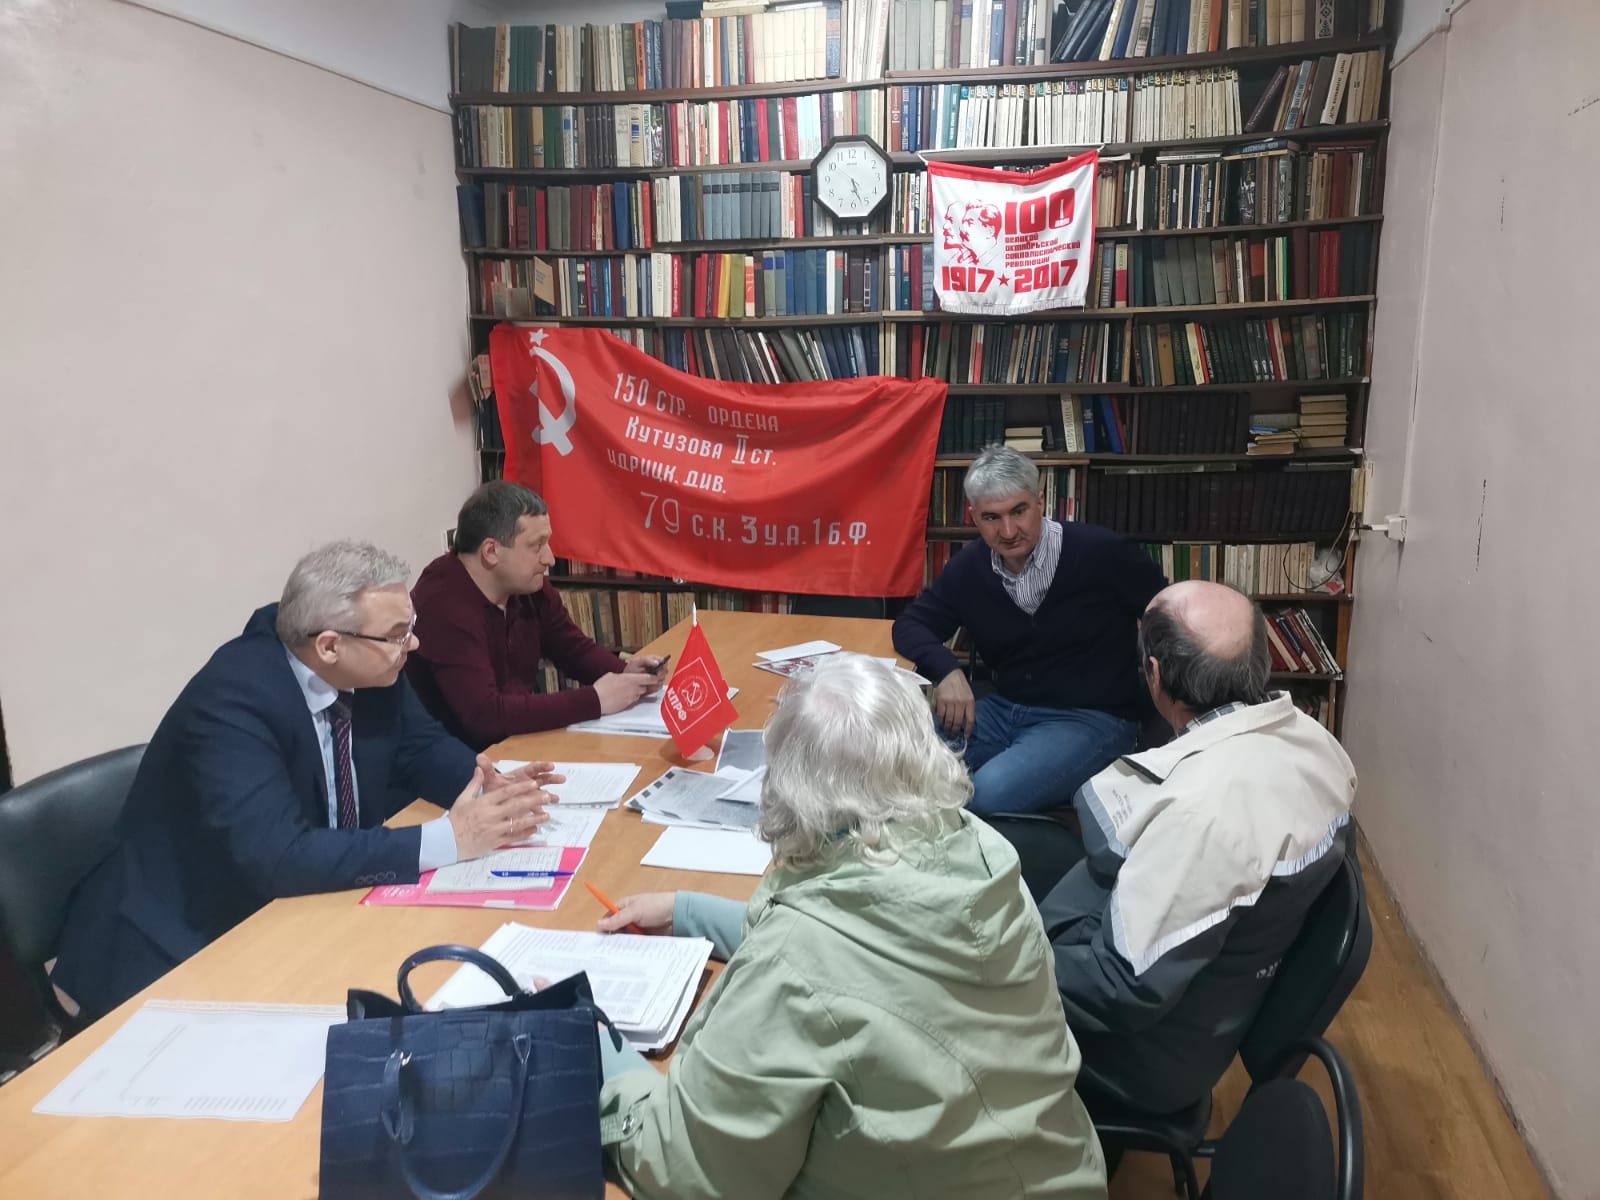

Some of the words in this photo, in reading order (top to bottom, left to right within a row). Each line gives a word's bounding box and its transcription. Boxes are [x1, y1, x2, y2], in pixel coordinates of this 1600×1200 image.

[837, 151, 844, 162] 11
[848, 148, 857, 159] 12
[863, 150, 867, 161] 1
[828, 161, 837, 172] 10
[871, 159, 877, 170] 2
[824, 175, 831, 185] 9
[875, 172, 881, 181] 3
[828, 188, 835, 198] 8
[871, 186, 878, 196] 4
[838, 198, 844, 208] 7
[850, 199, 857, 210] 6
[863, 196, 870, 207] 5
[1004, 187, 1076, 235] 100
[941, 265, 995, 293] 1917
[1014, 258, 1078, 294] 2017
[613, 372, 650, 408] 150
[655, 389, 692, 419] СТР.
[708, 405, 779, 433] ОРДЕНА
[683, 470, 727, 494] ДИВ.
[640, 490, 680, 533] 79
[740, 515, 758, 544] 3
[666, 687, 688, 721] КПРФ
